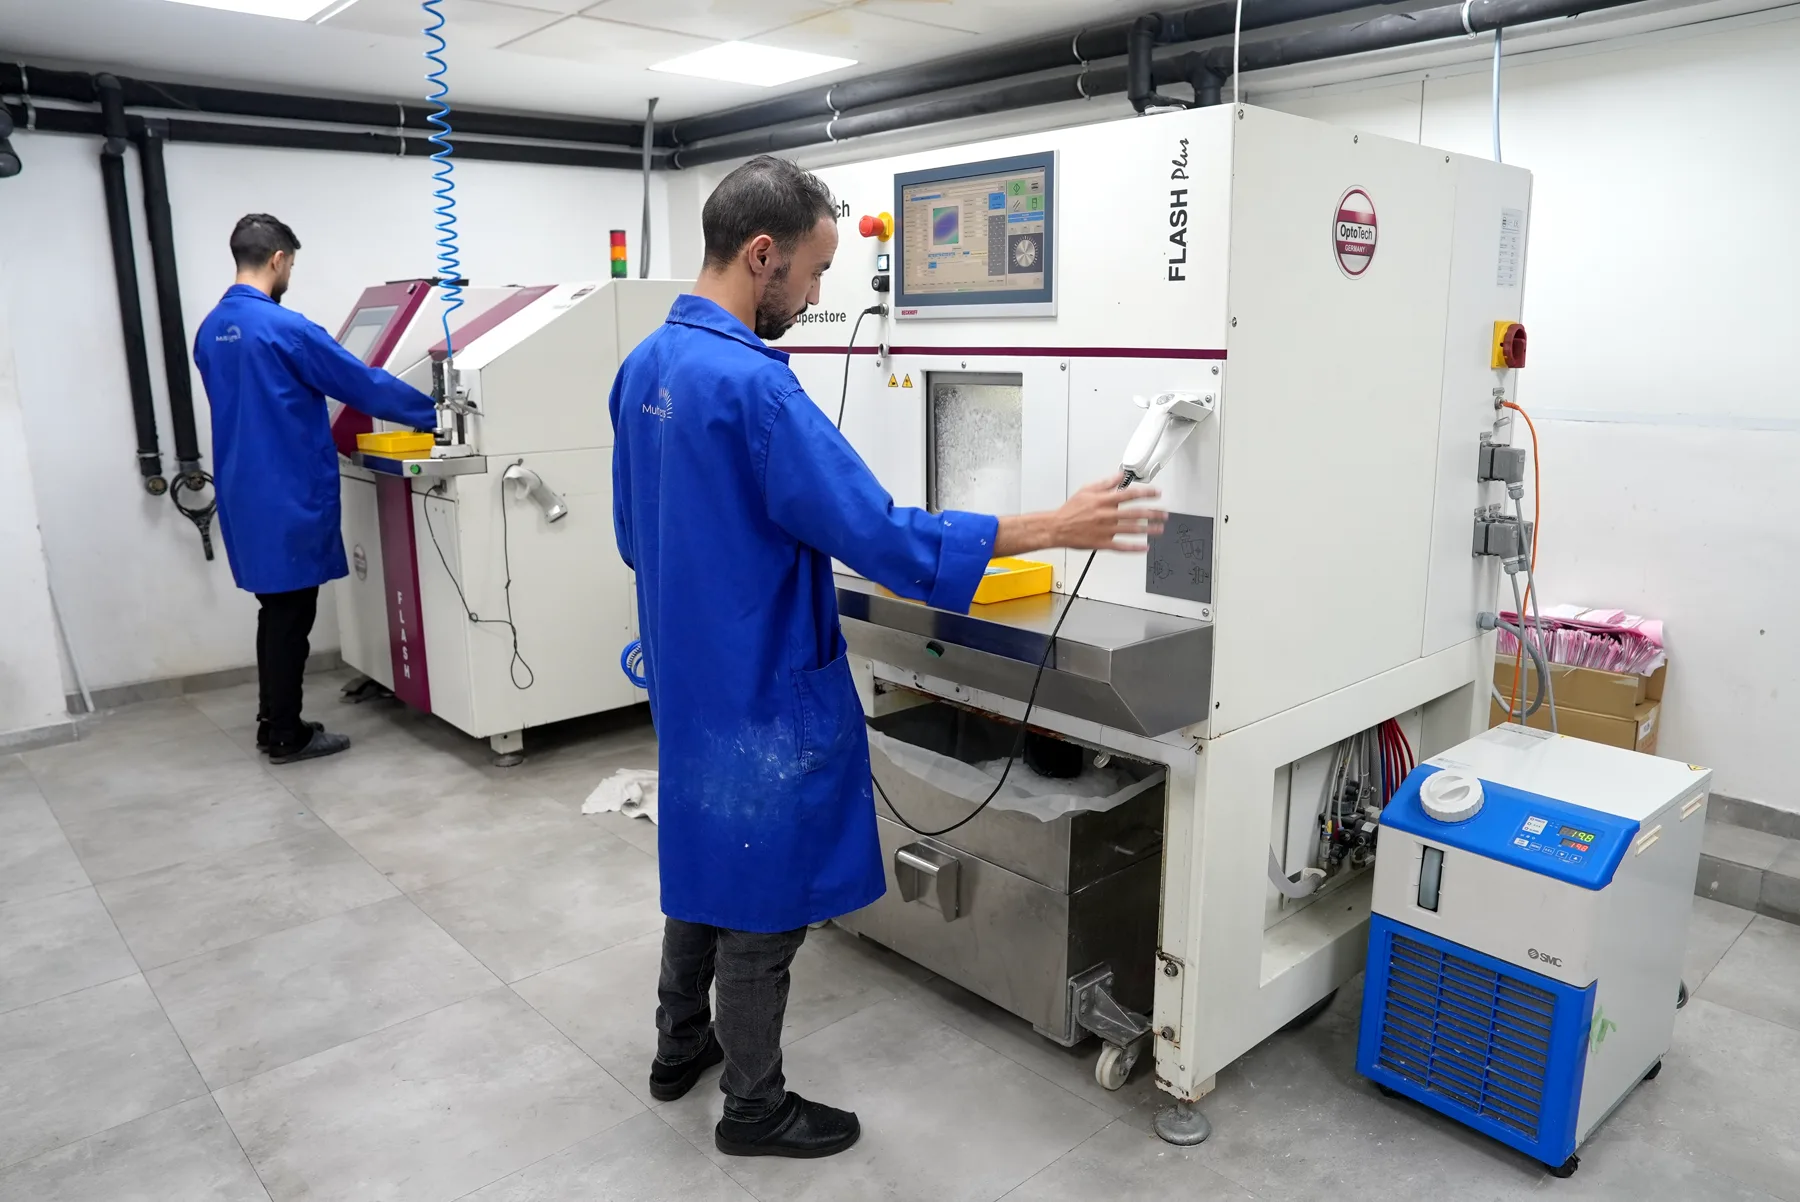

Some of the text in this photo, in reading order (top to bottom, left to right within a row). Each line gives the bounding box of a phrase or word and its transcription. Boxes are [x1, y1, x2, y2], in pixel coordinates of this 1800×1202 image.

[1168, 138, 1190, 281] FLASH Plus
[1340, 224, 1373, 241] OptoTech
[1344, 244, 1366, 253] GERMANY
[796, 310, 847, 326] uperstore
[397, 590, 411, 679] FLASH
[1539, 952, 1563, 968] SMC
